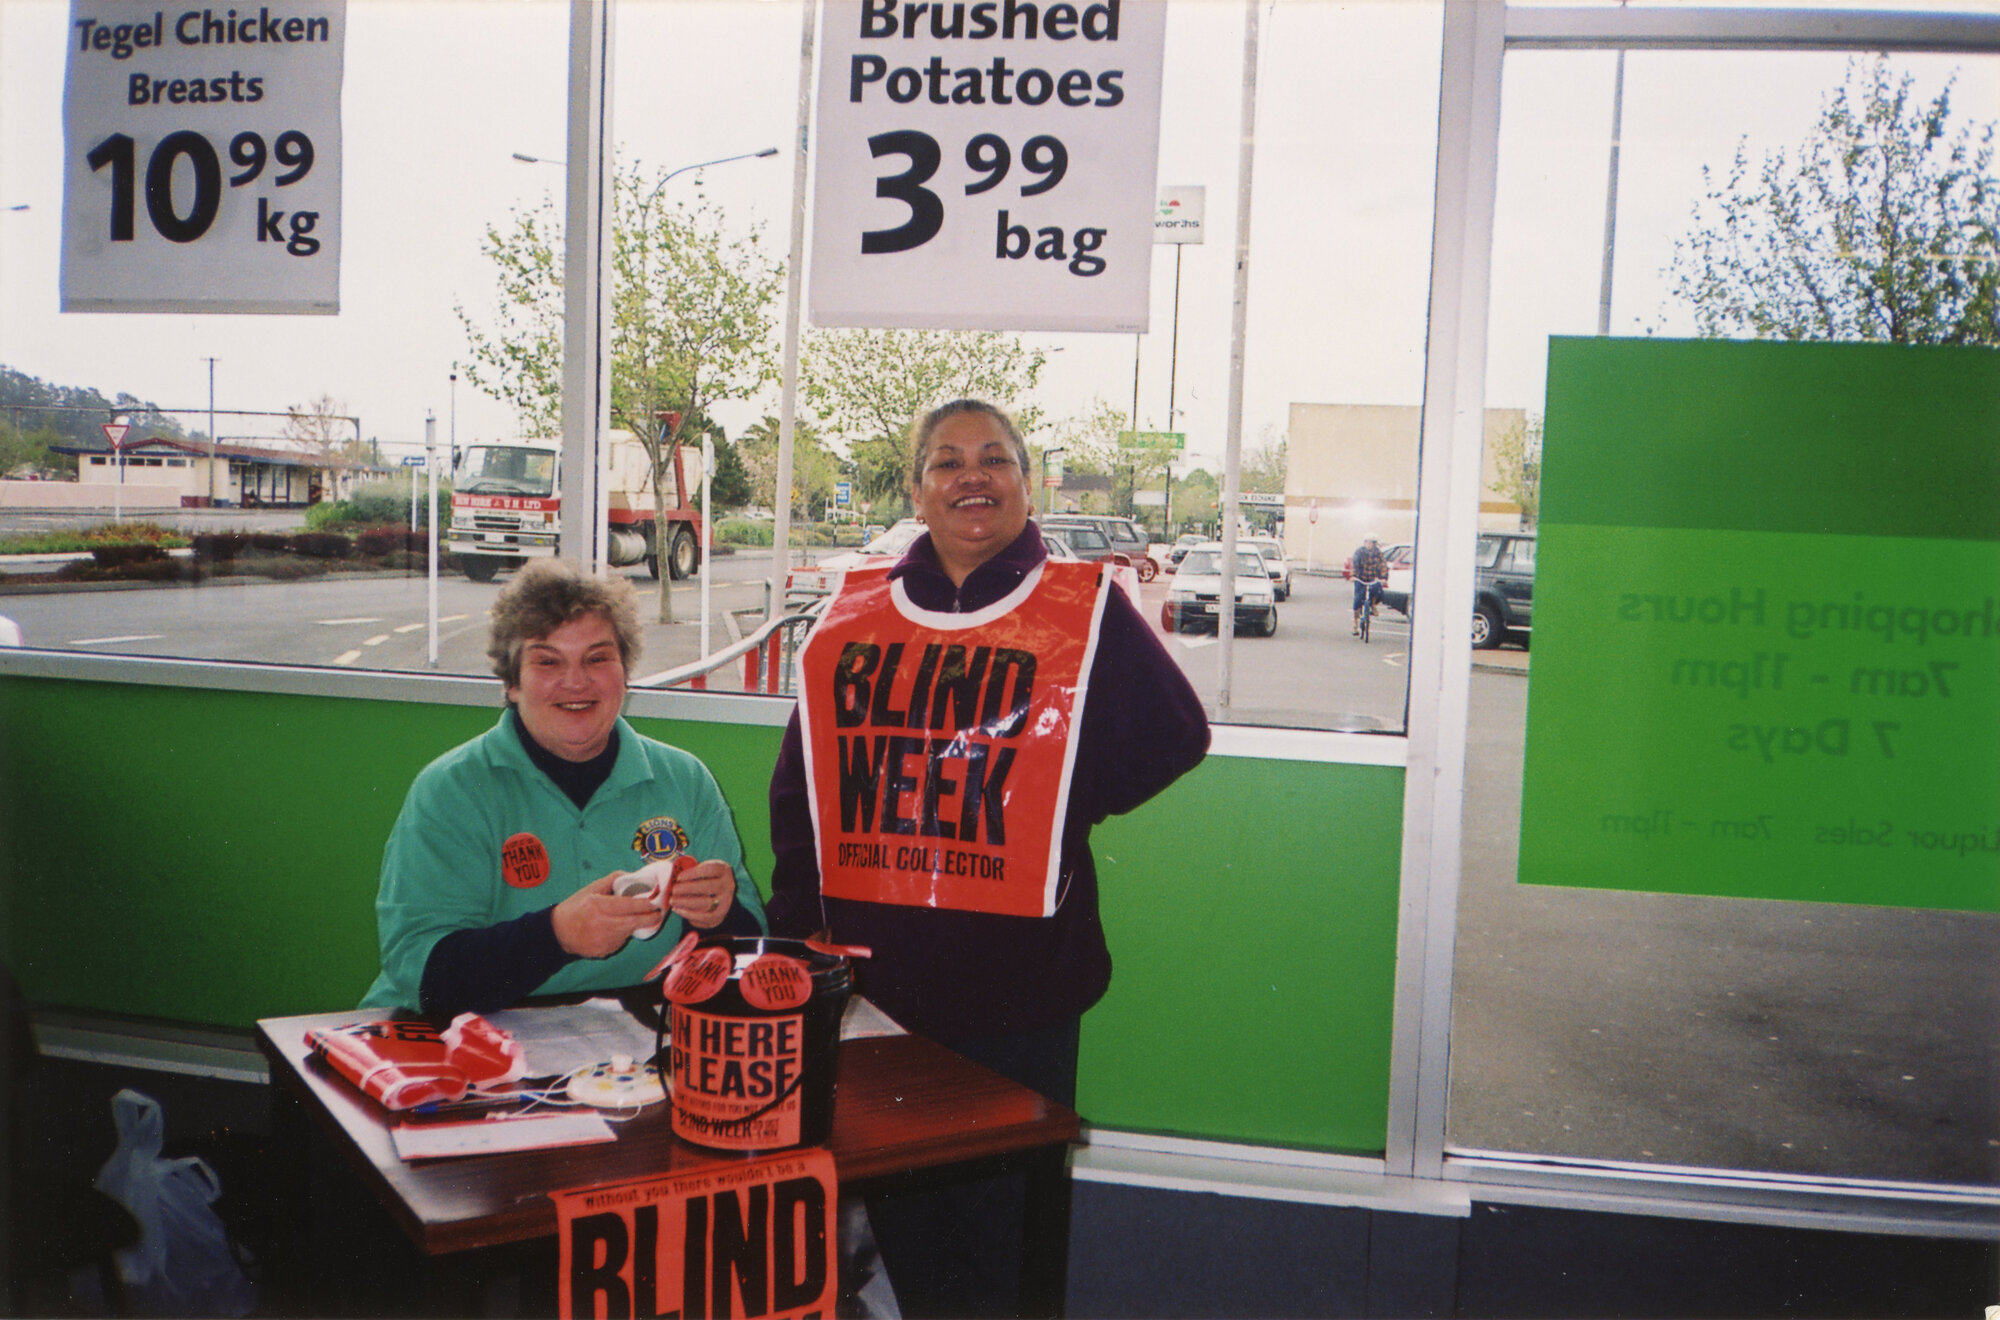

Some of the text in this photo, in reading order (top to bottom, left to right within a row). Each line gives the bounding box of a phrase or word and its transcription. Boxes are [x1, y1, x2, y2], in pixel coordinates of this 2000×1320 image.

[75, 7, 329, 60] Tegel Chicken
[860, 0, 1120, 41] Brushed
[128, 70, 264, 106] Breasts
[849, 54, 1124, 107] Potatoes
[257, 197, 321, 257] kg
[996, 209, 1108, 277] bag
[523, 500, 542, 510] LTD
[833, 642, 1038, 739] BLIND
[837, 735, 1017, 846] WEEK
[642, 819, 675, 833] LIONS
[652, 831, 671, 853] L
[502, 844, 545, 869] THANK
[513, 861, 541, 882] YOU
[838, 842, 1005, 881] OFFICIAL COLLECTOR
[745, 966, 804, 988] THANK
[762, 984, 797, 1003] YOU
[672, 1005, 797, 1058] IN HERE
[673, 1046, 797, 1099] PLEASE
[585, 1187, 638, 1208] Without
[645, 1184, 668, 1201] you
[673, 1177, 712, 1194] there
[777, 1160, 793, 1176] be
[571, 1176, 827, 1320] BLIND
